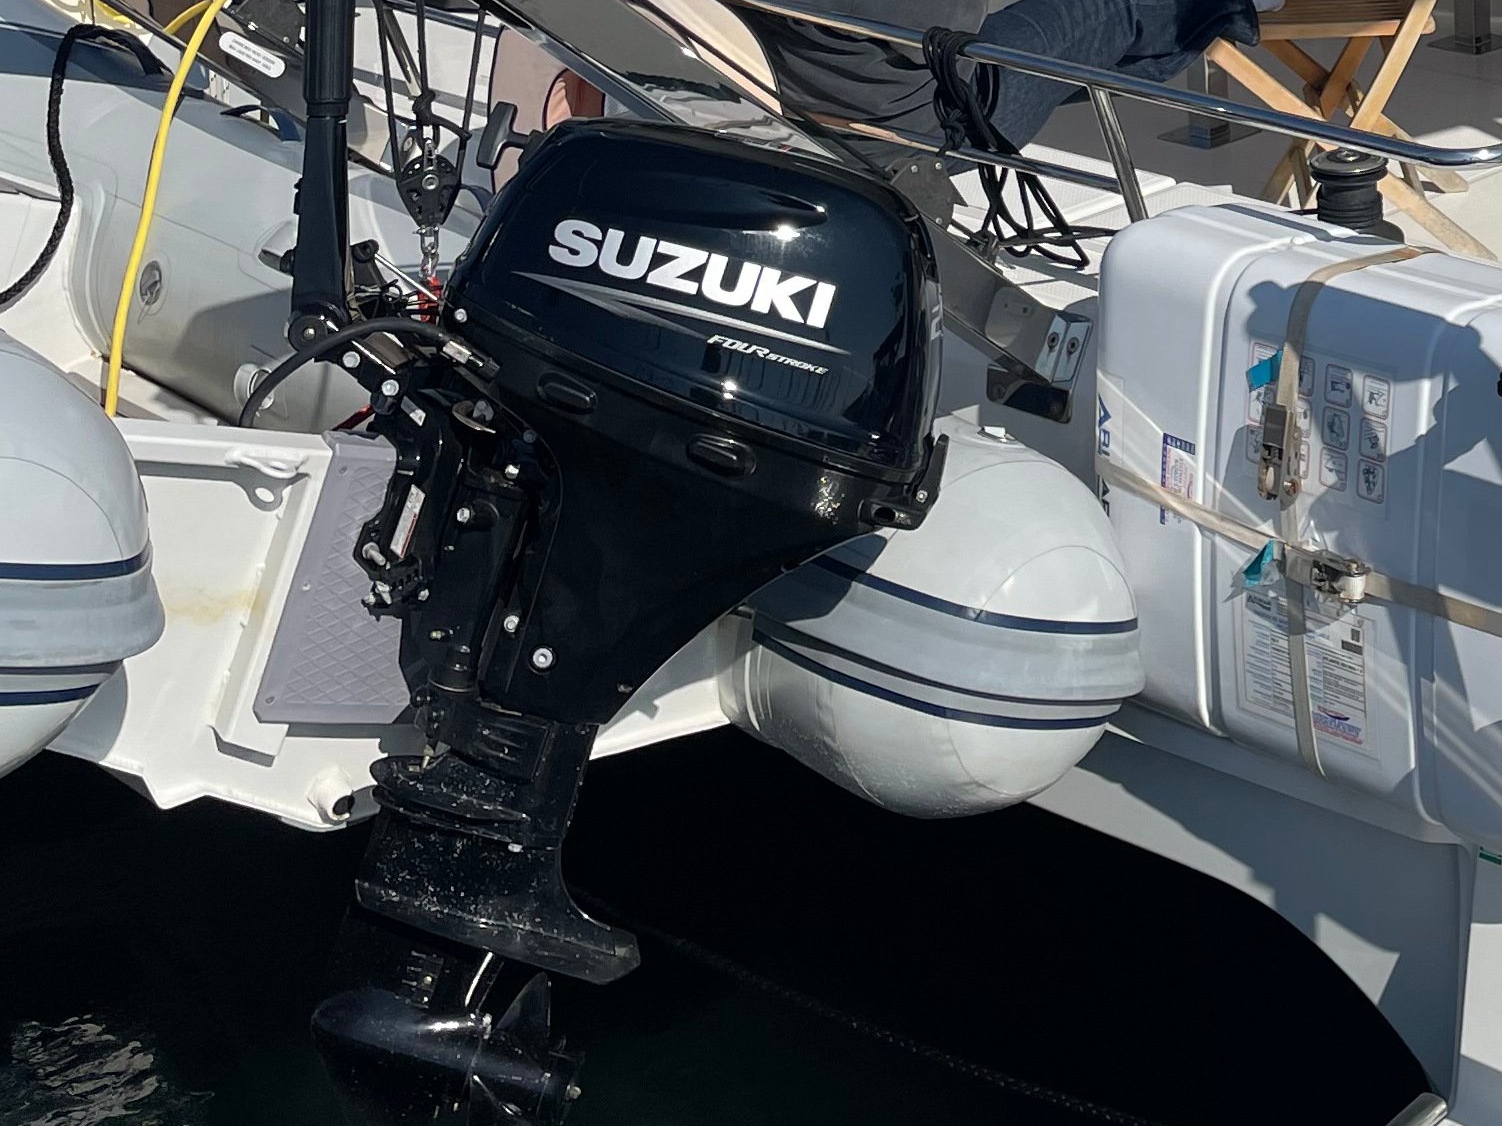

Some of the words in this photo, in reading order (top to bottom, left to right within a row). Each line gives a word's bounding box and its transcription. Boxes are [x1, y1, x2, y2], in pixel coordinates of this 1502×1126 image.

[548, 219, 836, 329] SUZUKI
[706, 334, 770, 358] FOUR
[765, 353, 829, 375] STROKE
